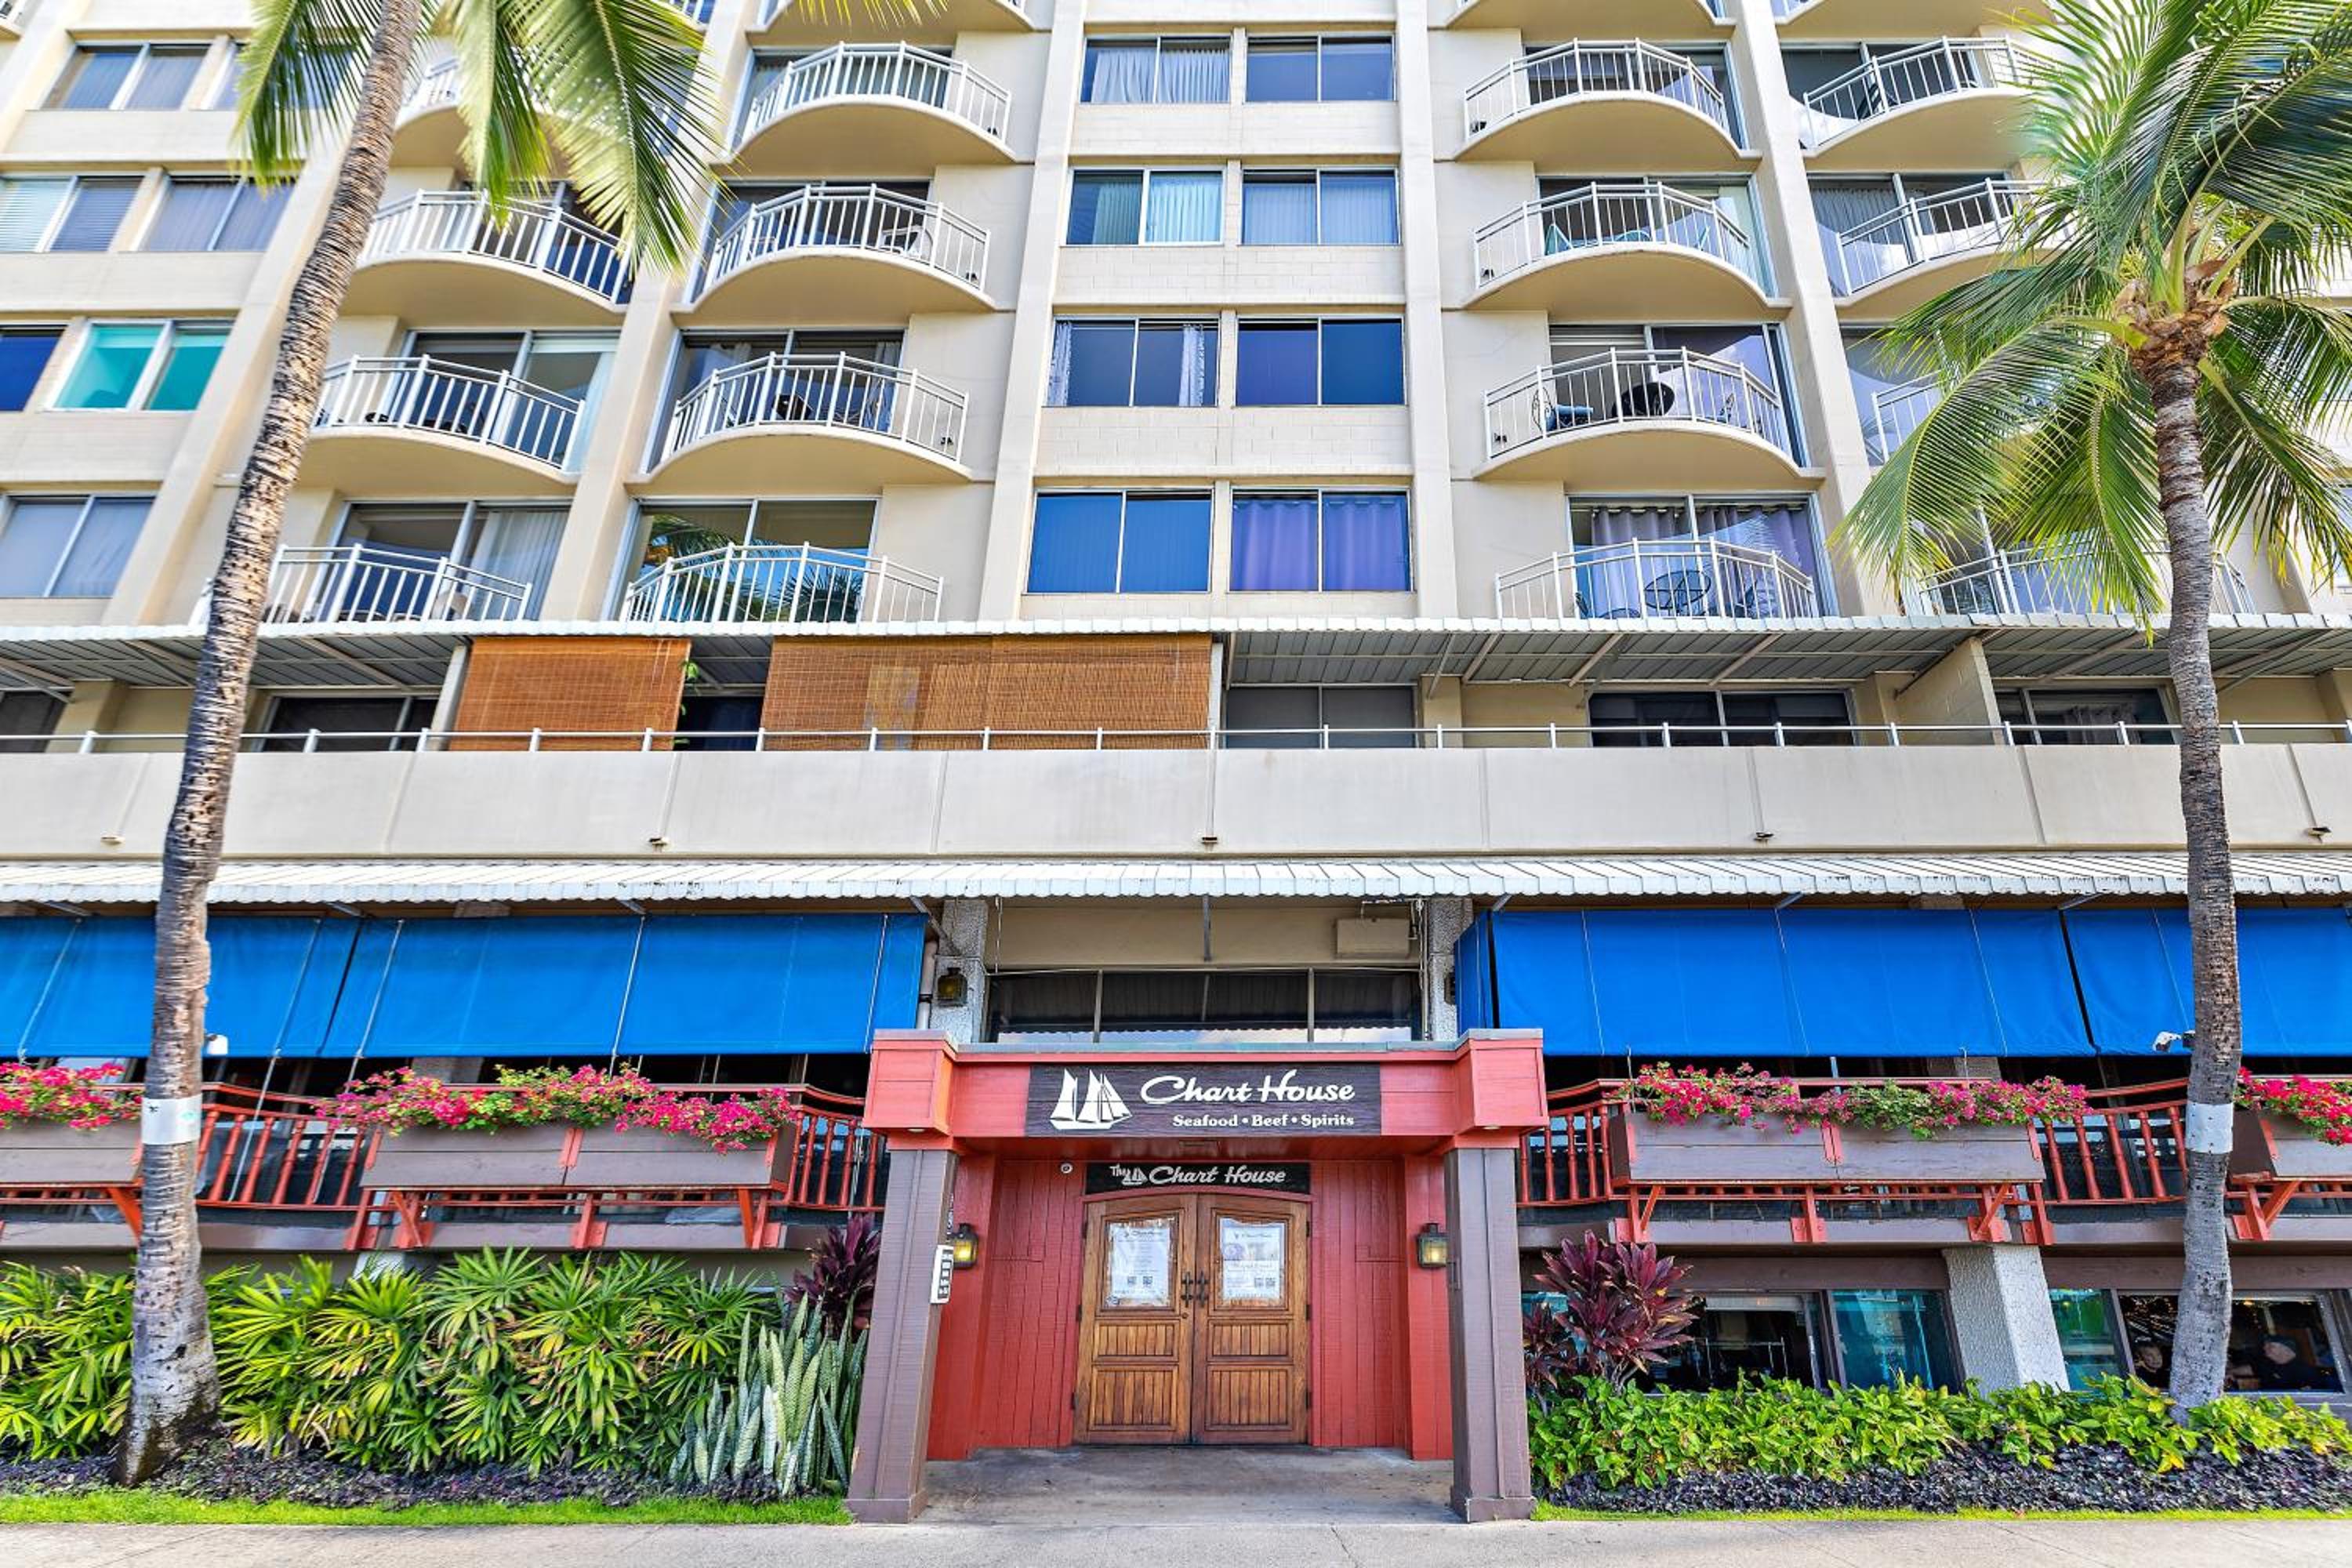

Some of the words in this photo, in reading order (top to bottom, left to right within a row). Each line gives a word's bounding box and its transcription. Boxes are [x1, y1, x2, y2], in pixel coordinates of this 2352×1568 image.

[1141, 1075, 1252, 1104] Chart
[1257, 1069, 1356, 1102] House
[1173, 1113, 1239, 1127] Seafood
[1251, 1113, 1288, 1127] Beef
[1301, 1113, 1355, 1128] Spirits
[1149, 1165, 1219, 1185] Chart
[1224, 1164, 1287, 1184] House
